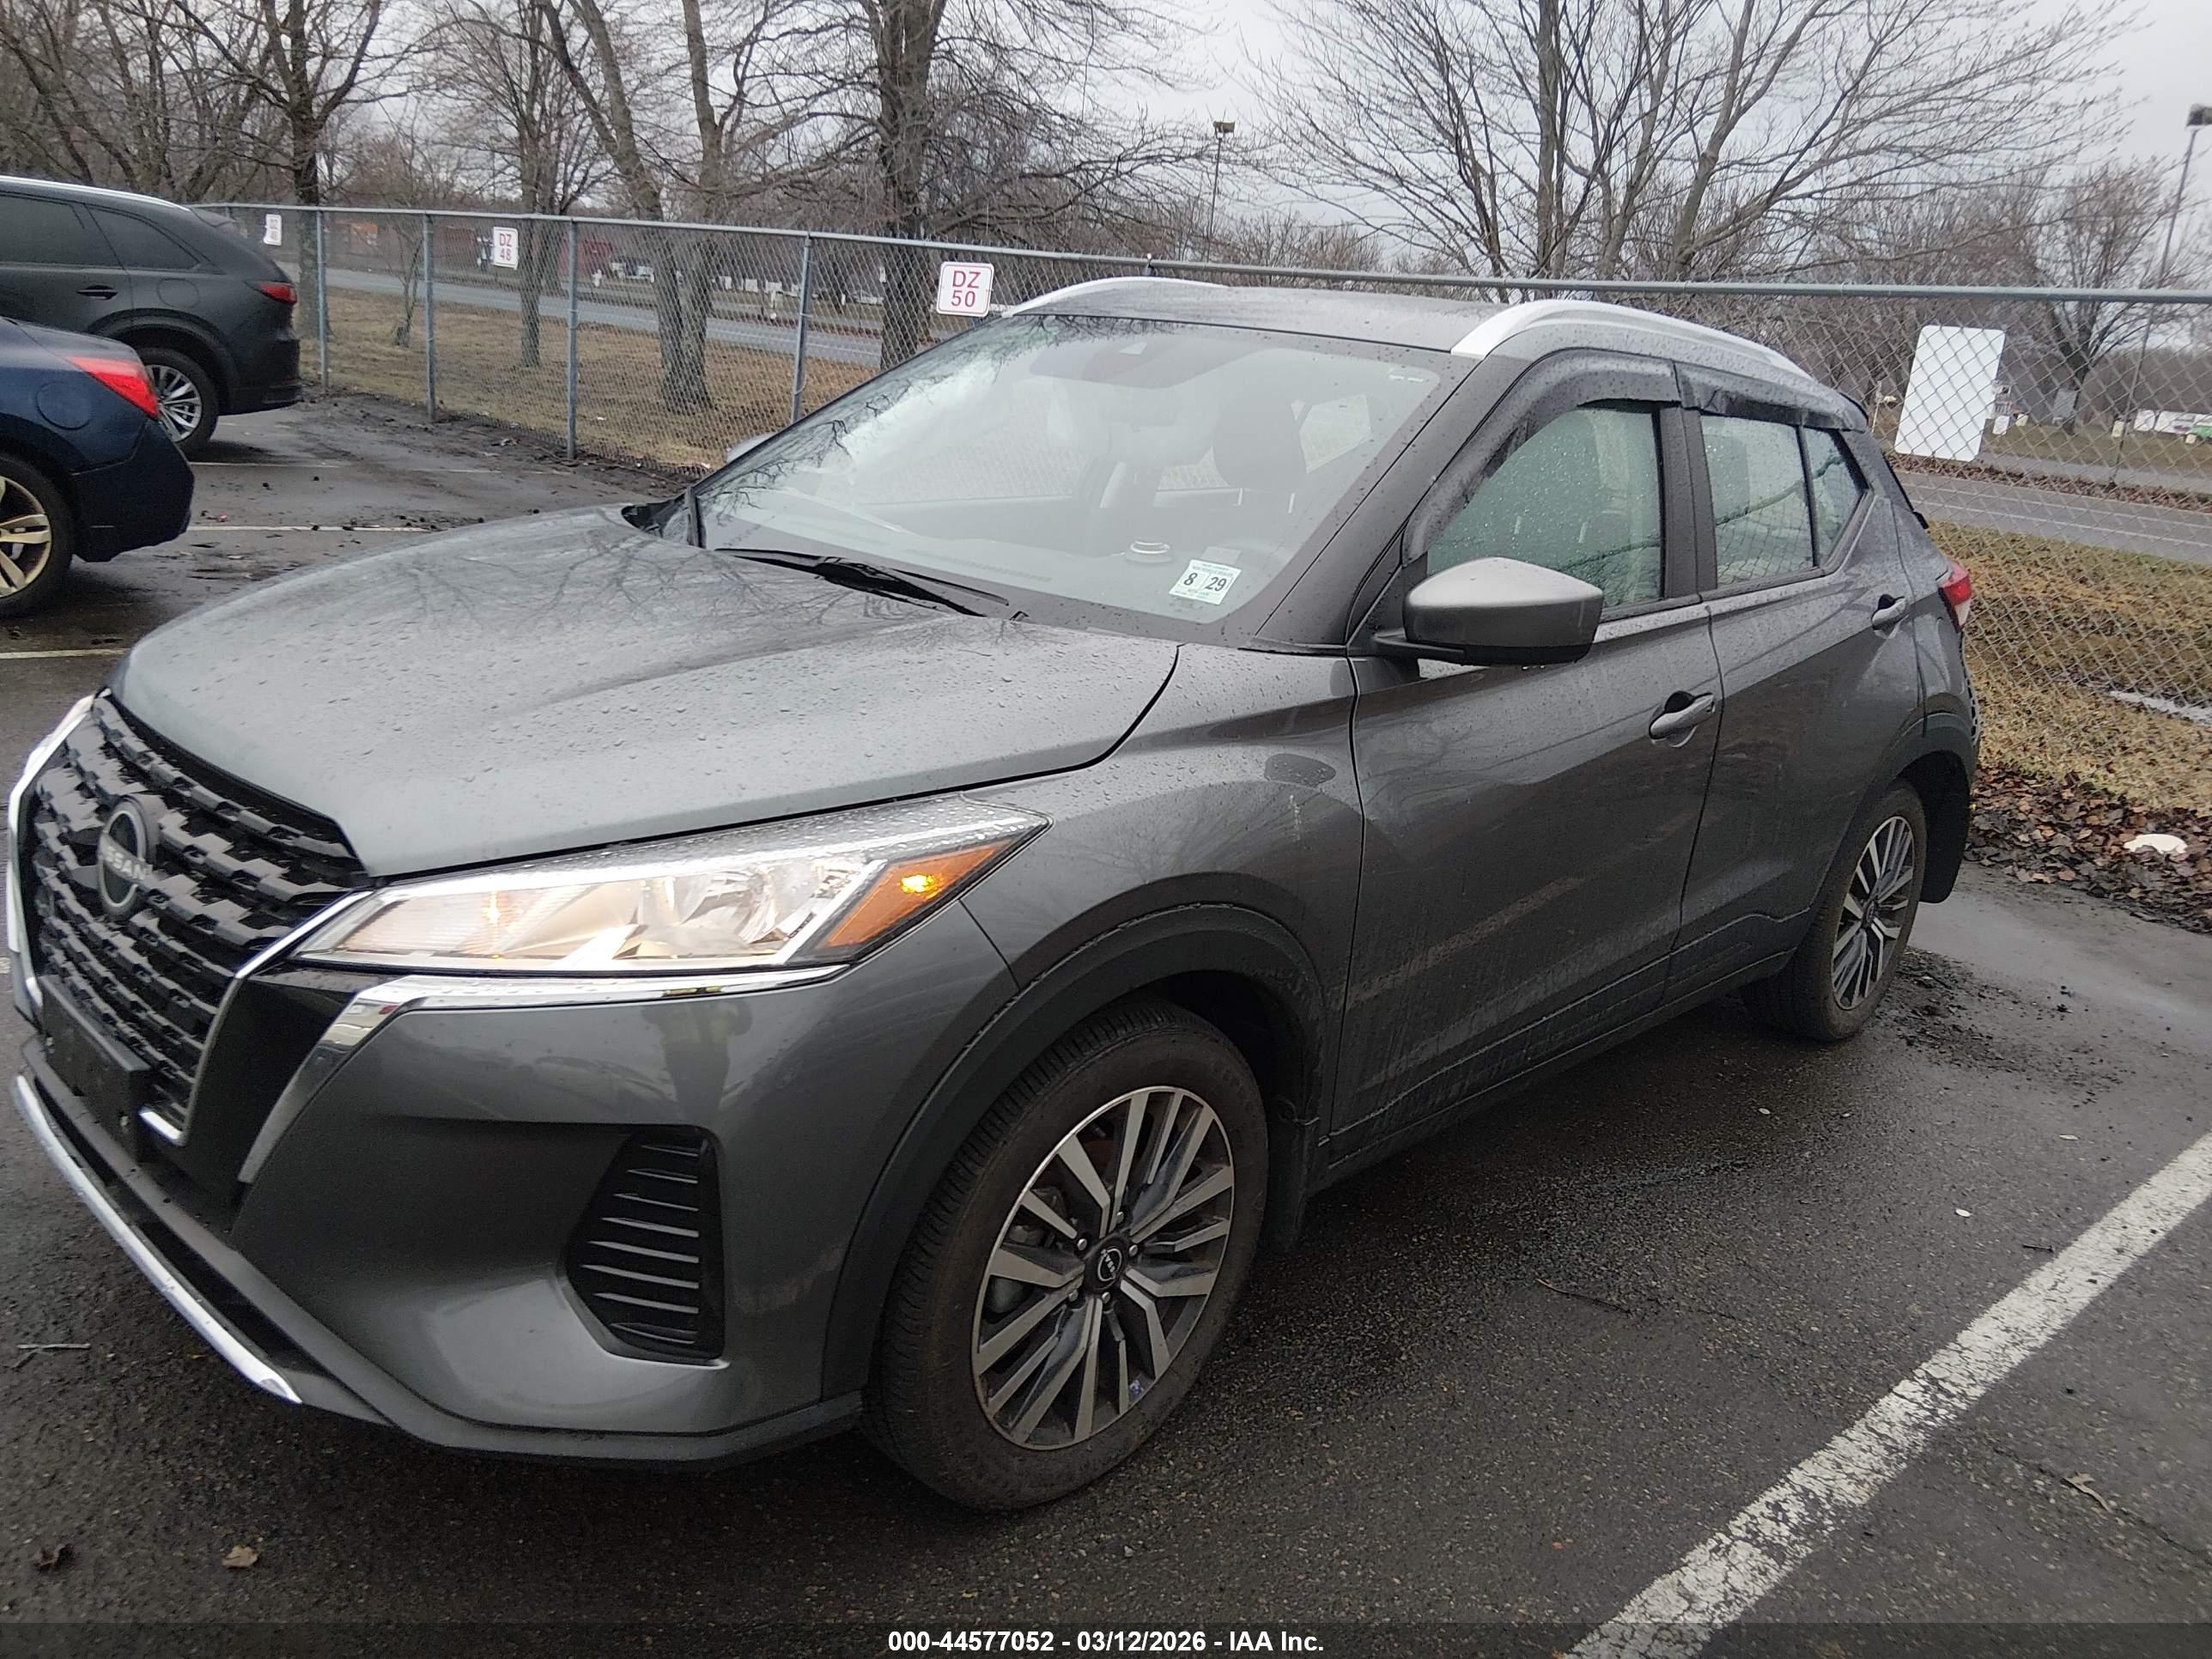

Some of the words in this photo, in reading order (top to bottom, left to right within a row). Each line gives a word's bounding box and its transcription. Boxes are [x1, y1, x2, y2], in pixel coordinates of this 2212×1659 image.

[499, 233, 513, 247] DZ
[952, 270, 981, 289] DZ
[951, 289, 976, 307] 50
[1183, 572, 1199, 586] 8
[1204, 576, 1227, 592] 29
